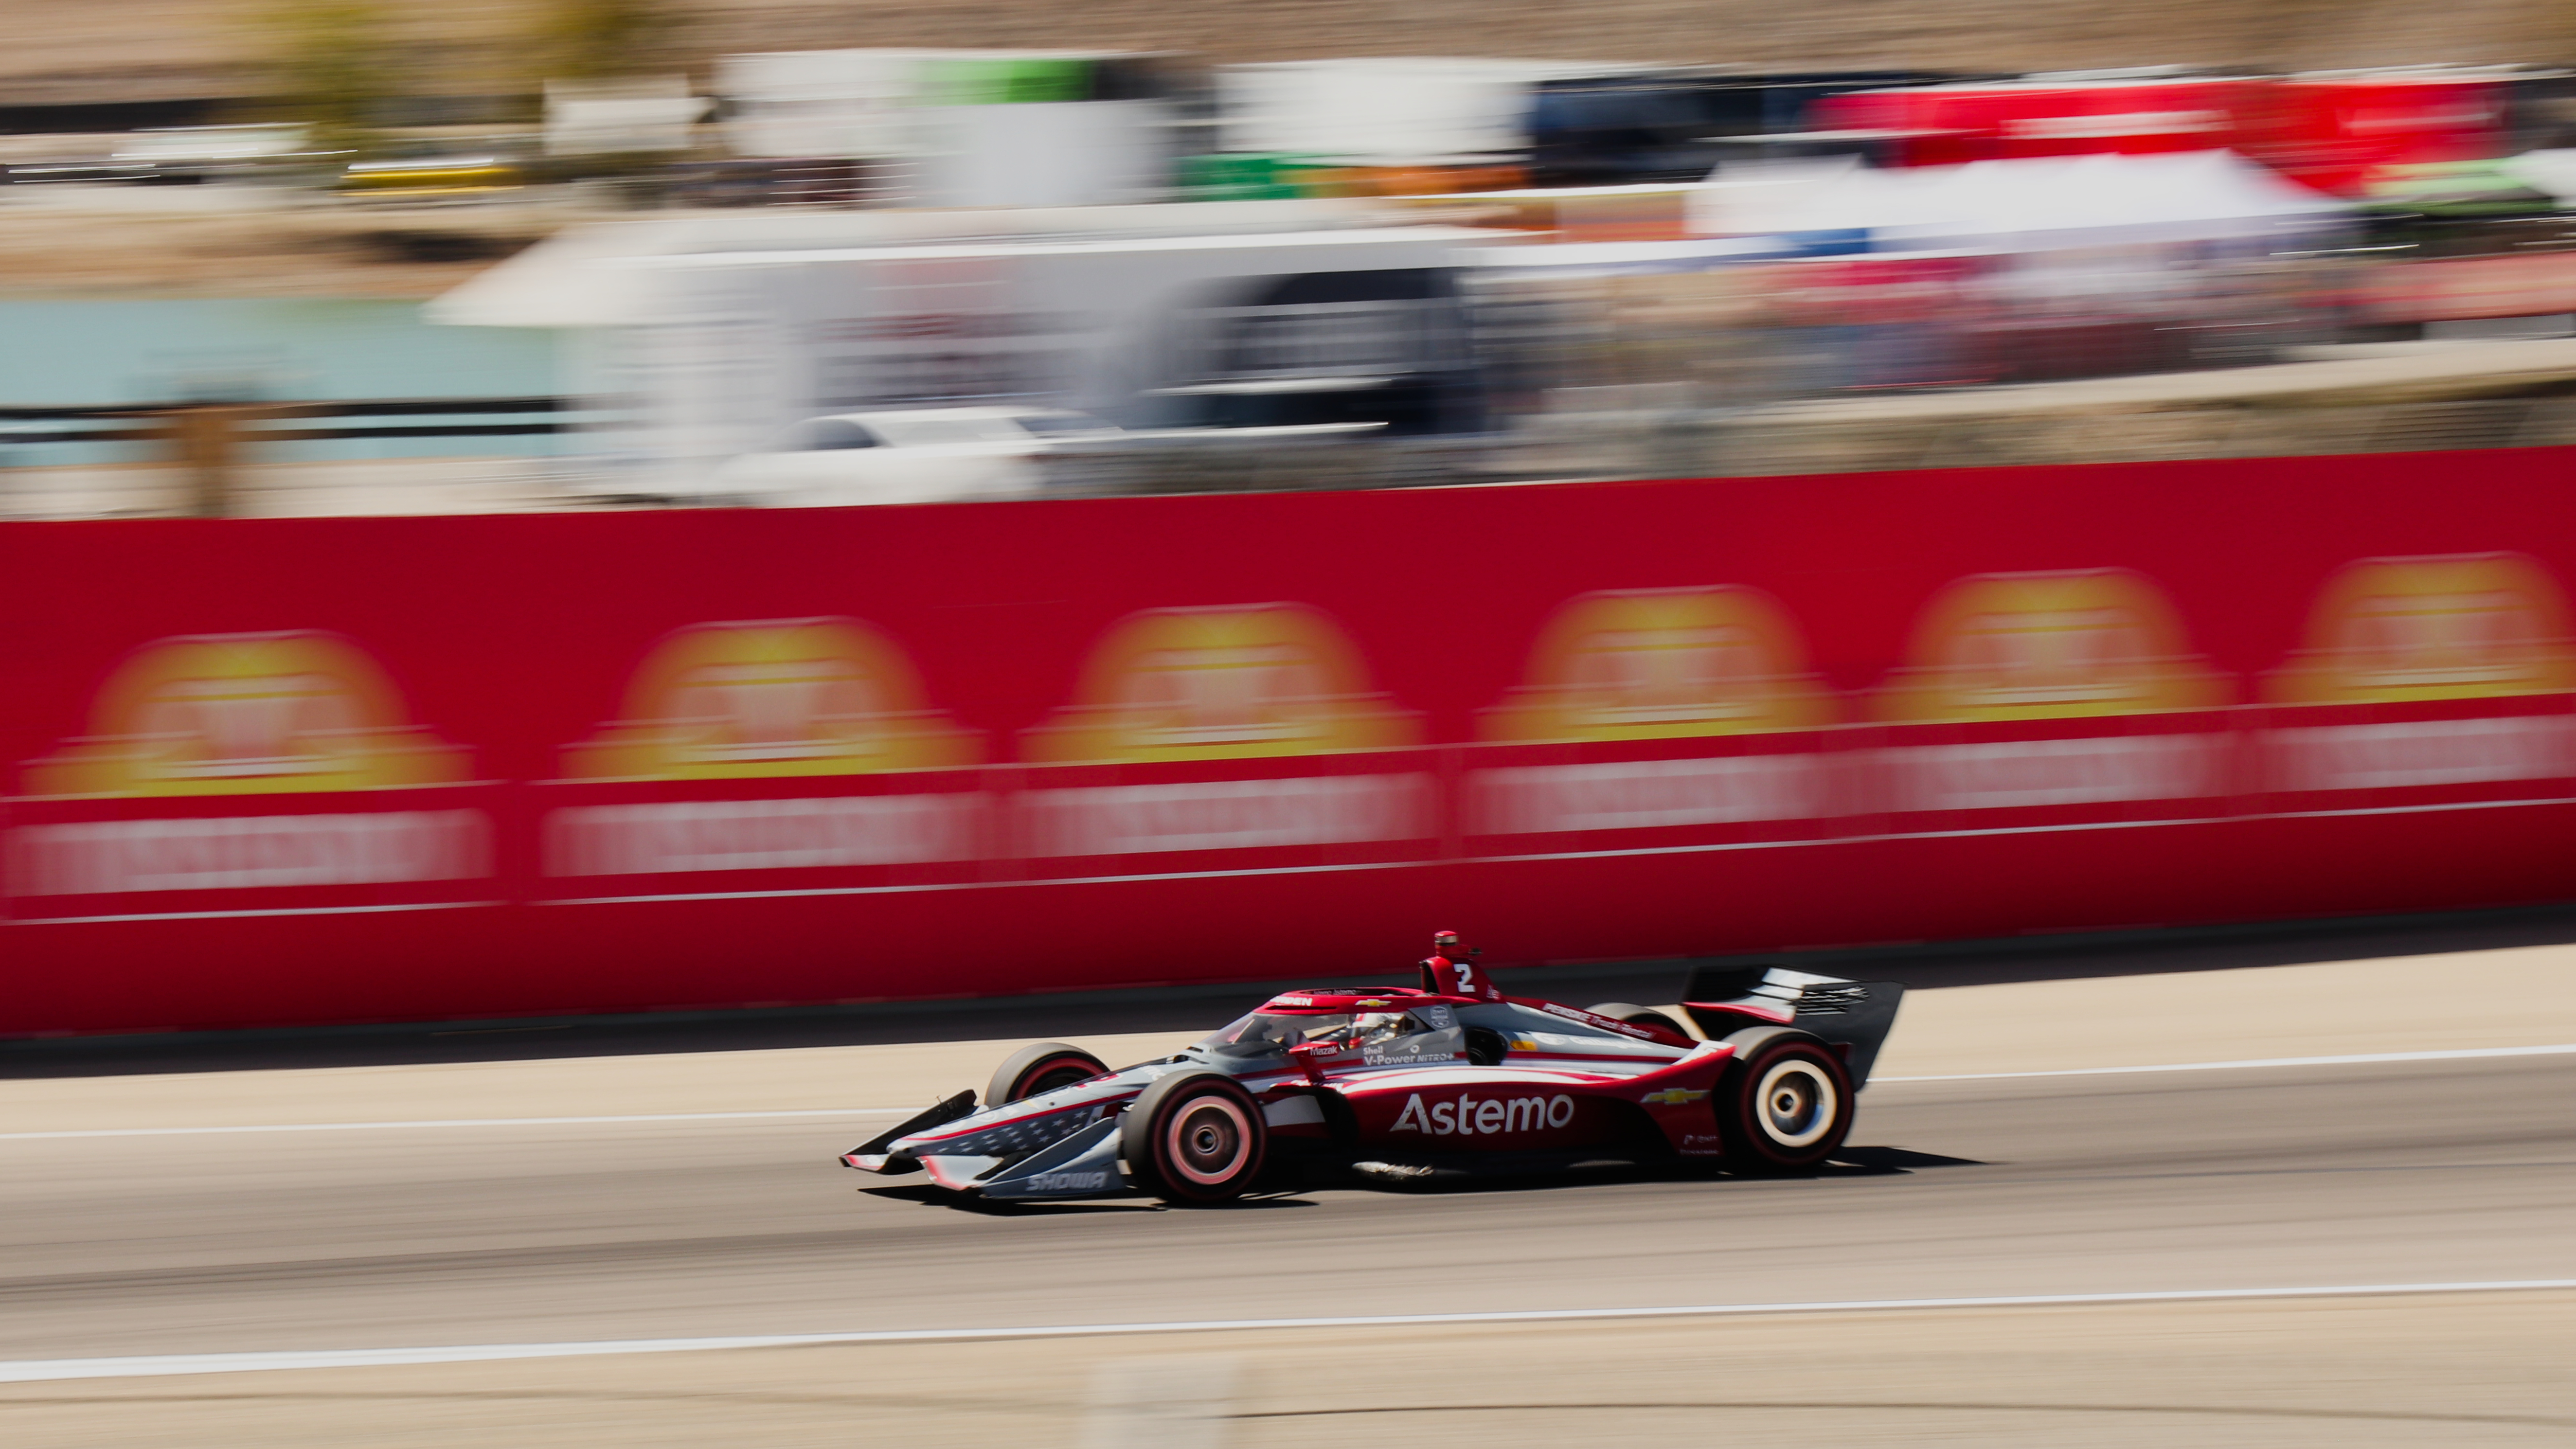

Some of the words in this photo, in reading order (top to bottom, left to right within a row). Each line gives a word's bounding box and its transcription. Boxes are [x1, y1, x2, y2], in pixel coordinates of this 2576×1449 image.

[1453, 964, 1476, 993] 2
[1310, 1046, 1338, 1056] Mazak
[1363, 1046, 1383, 1055] Shell
[1363, 1055, 1415, 1066] V-Power
[1389, 1092, 1574, 1136] Astemo
[1025, 1171, 1109, 1191] SHOWA
